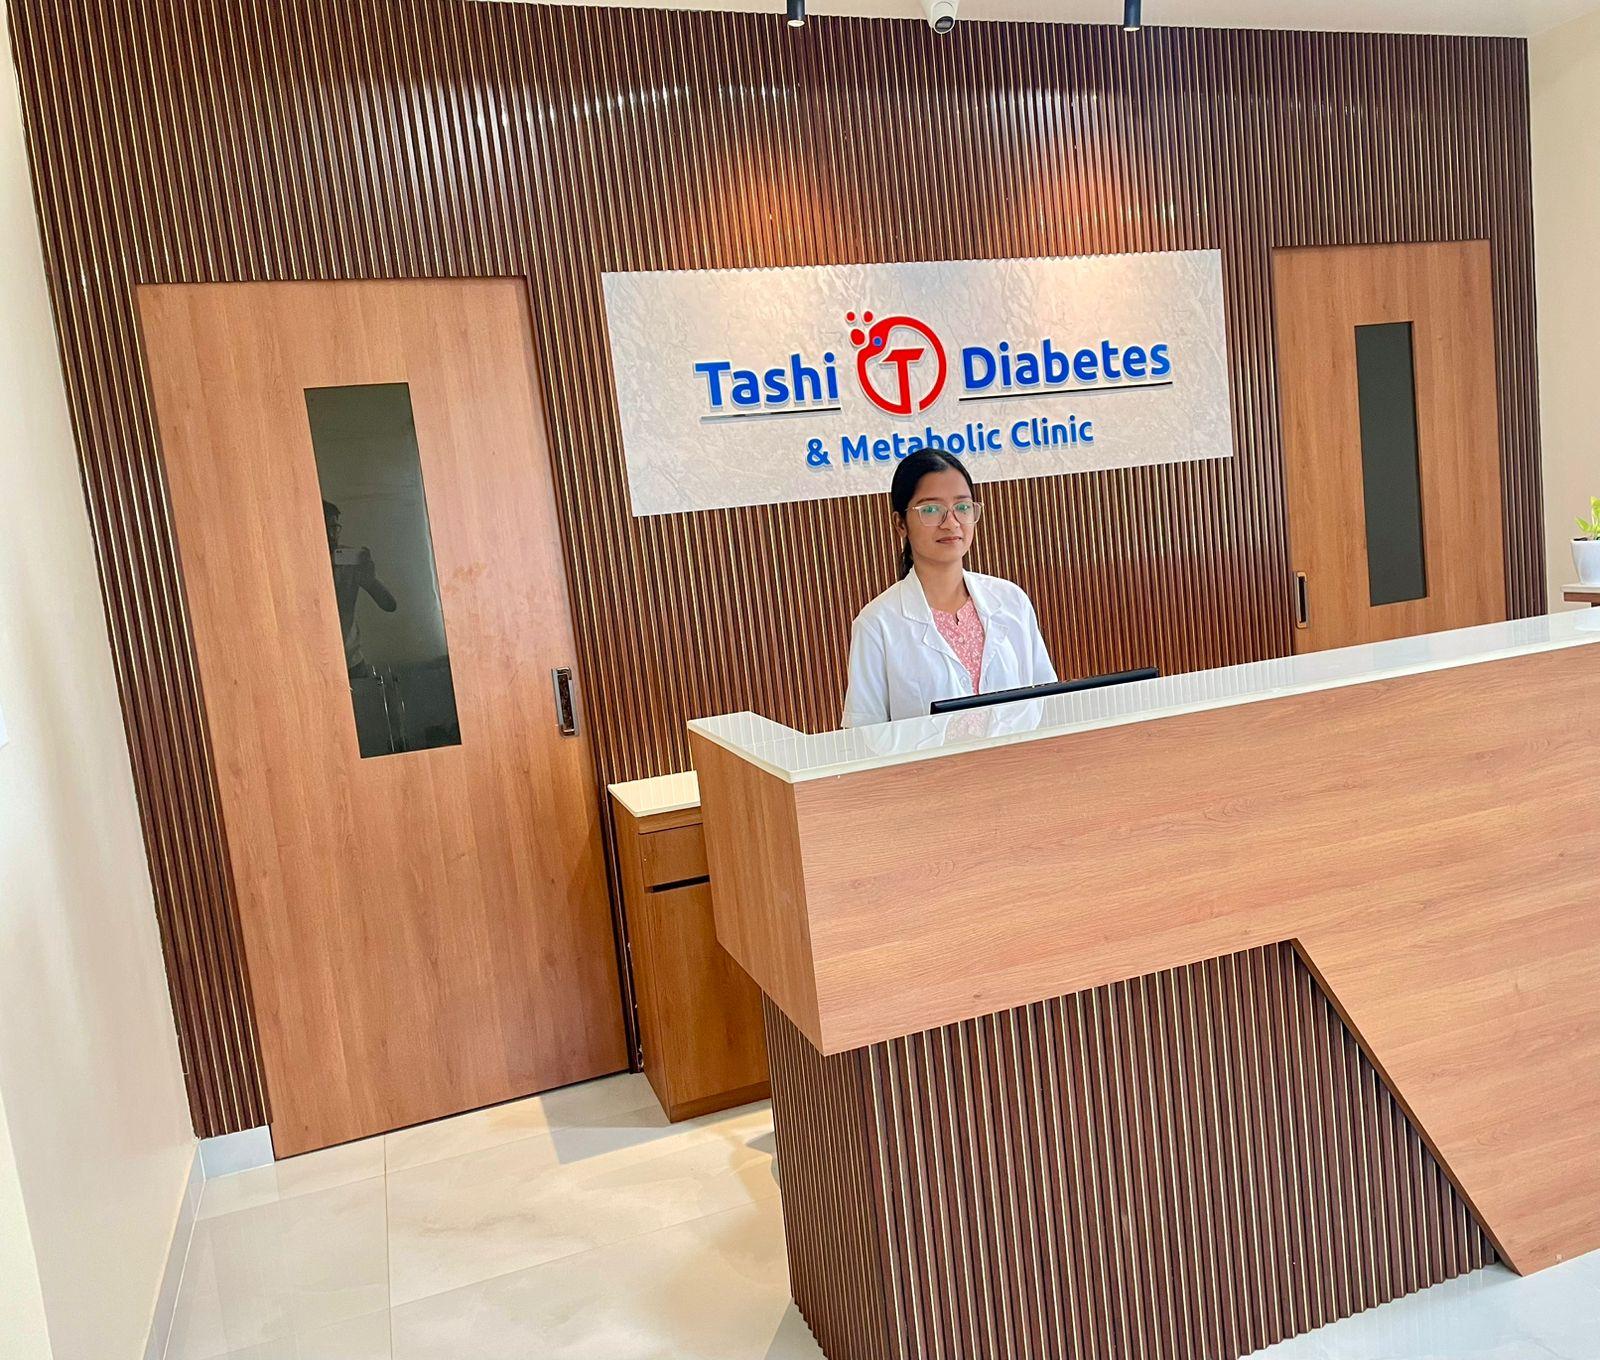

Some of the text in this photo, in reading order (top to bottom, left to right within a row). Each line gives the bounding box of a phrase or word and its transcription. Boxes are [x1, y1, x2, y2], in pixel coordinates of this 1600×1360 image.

[695, 352, 839, 407] Tashi
[962, 339, 1171, 390] Diabetes
[807, 415, 1094, 468] & Metabolic Clinic
